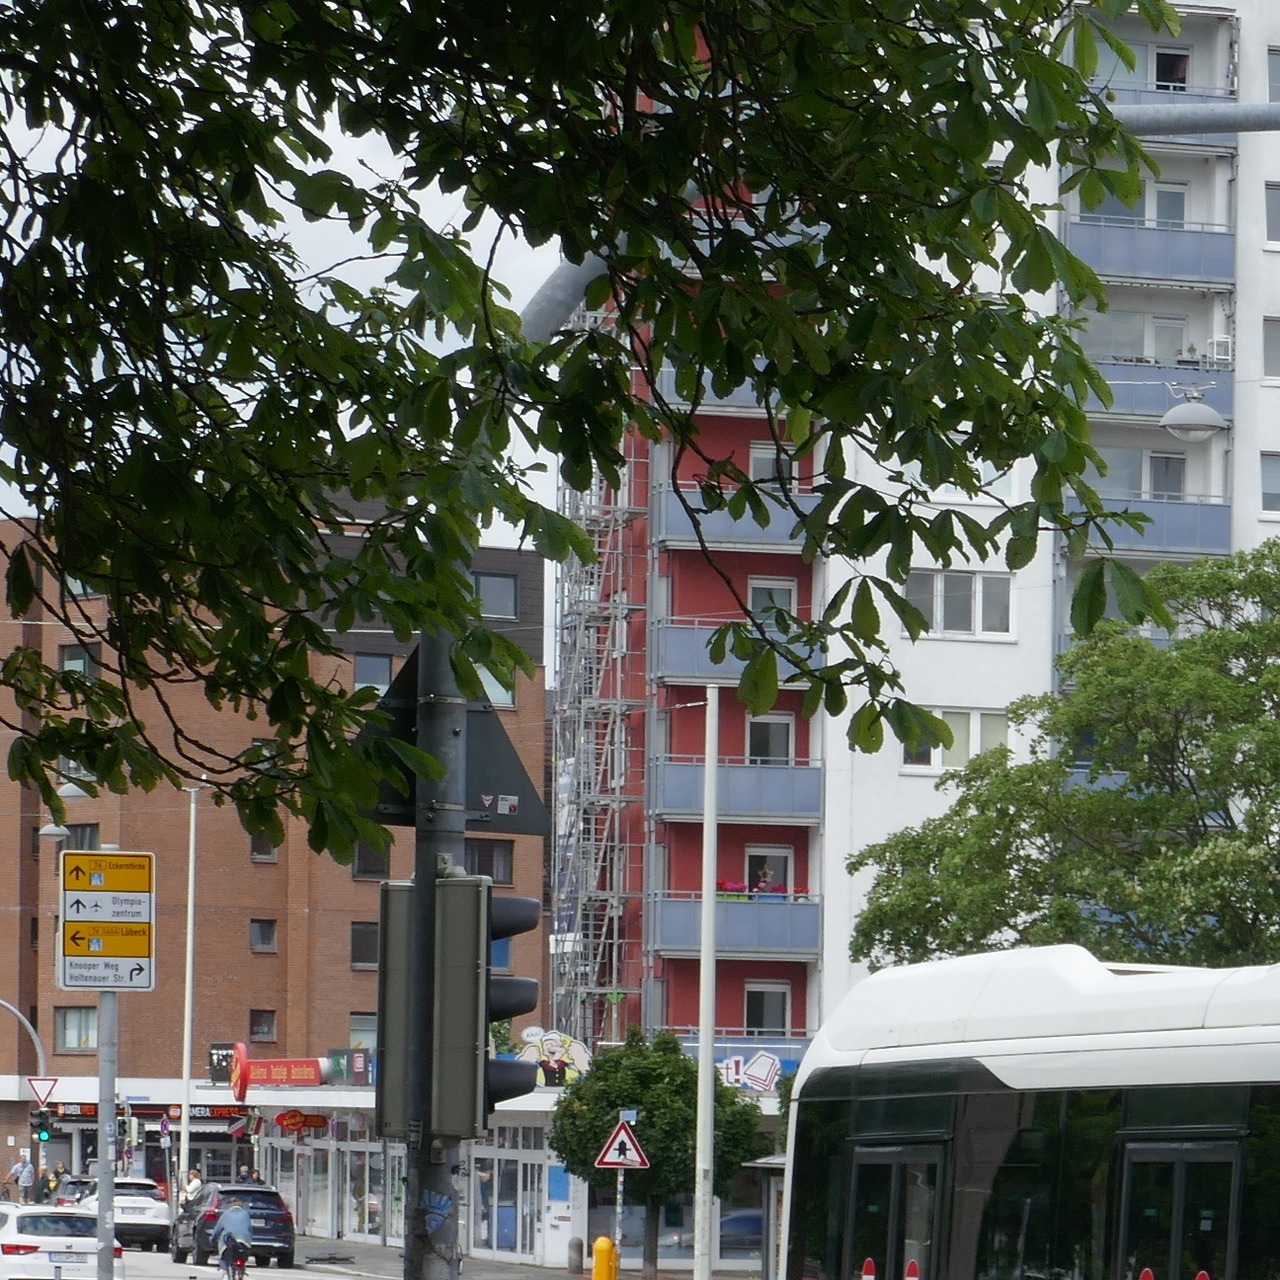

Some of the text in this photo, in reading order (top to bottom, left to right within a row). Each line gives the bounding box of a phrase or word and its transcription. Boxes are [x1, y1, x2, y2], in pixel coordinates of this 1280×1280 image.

[108, 860, 146, 871] Eckernförde
[111, 896, 147, 907] Olympia-
[111, 910, 143, 918] zentrum
[120, 927, 147, 937] Lübeck
[69, 961, 120, 972] Knooper Weg
[69, 974, 110, 983] Holtenauer
